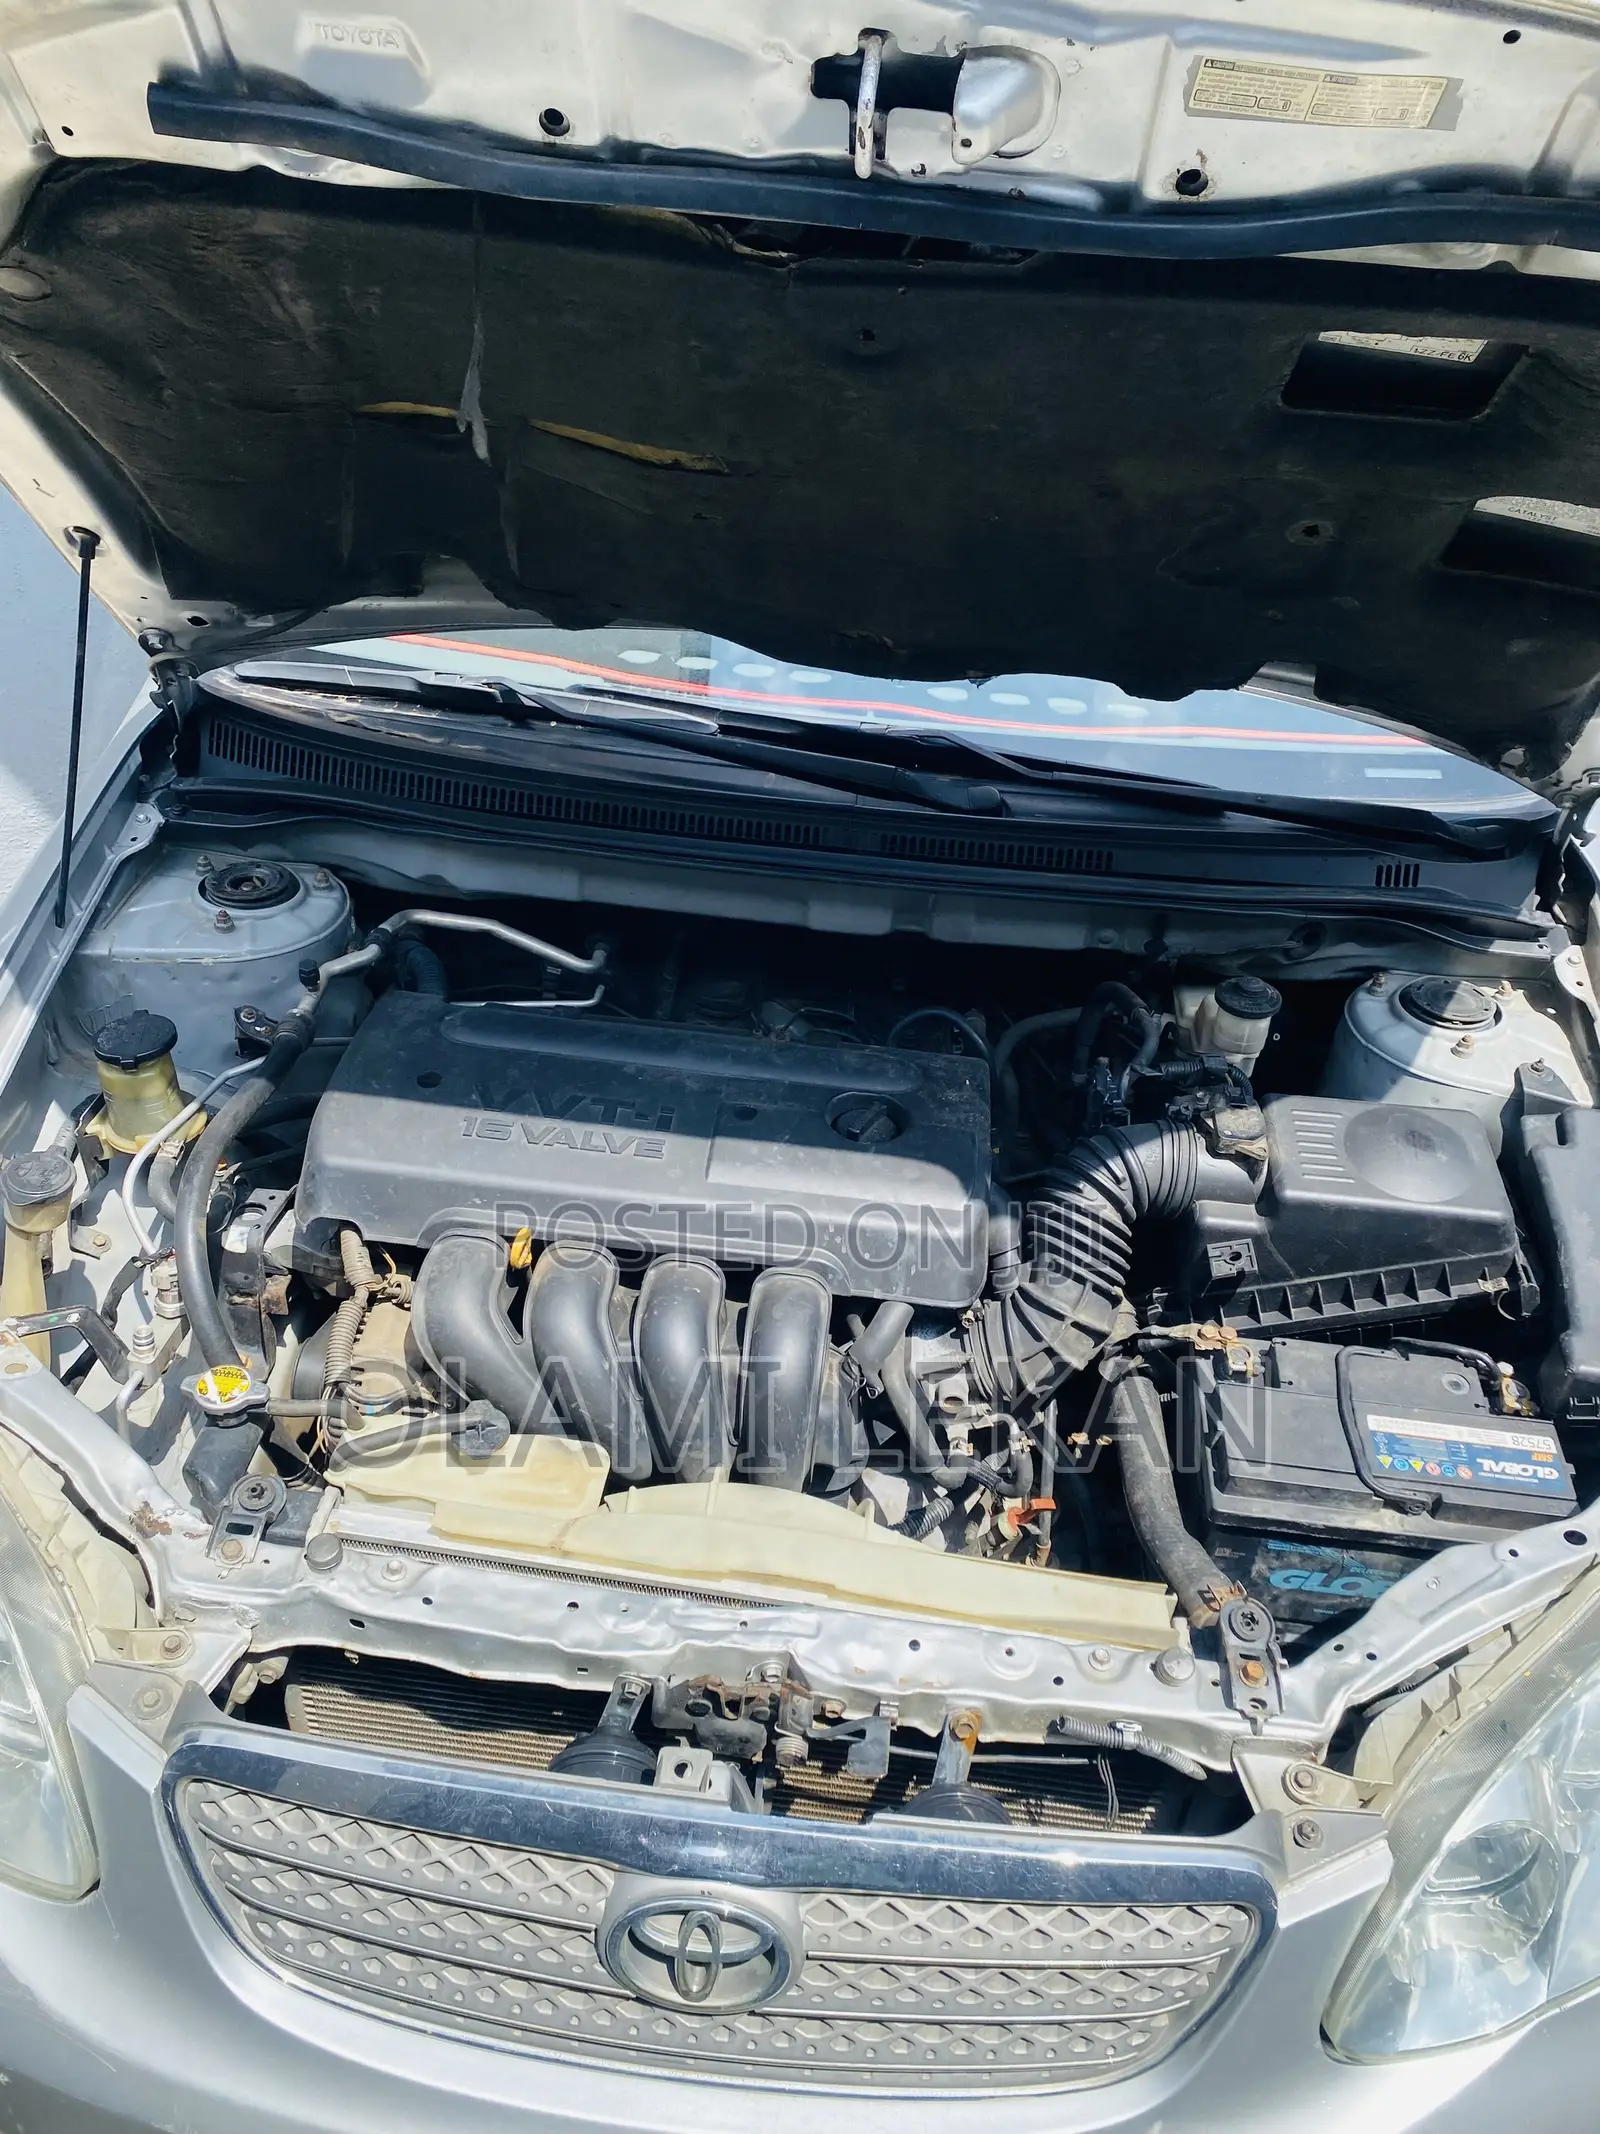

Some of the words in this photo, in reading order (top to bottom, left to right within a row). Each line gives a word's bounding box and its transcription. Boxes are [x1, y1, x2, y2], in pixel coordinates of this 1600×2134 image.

[314, 22, 400, 49] TOYOTA
[1507, 506, 1557, 521] CATALYST
[461, 1115, 515, 1141] 16
[520, 1122, 667, 1160] VALVE
[1511, 1435, 1552, 1450] 57528
[1531, 1451, 1554, 1463] SMF
[1476, 1457, 1560, 1480] GLOBAL
